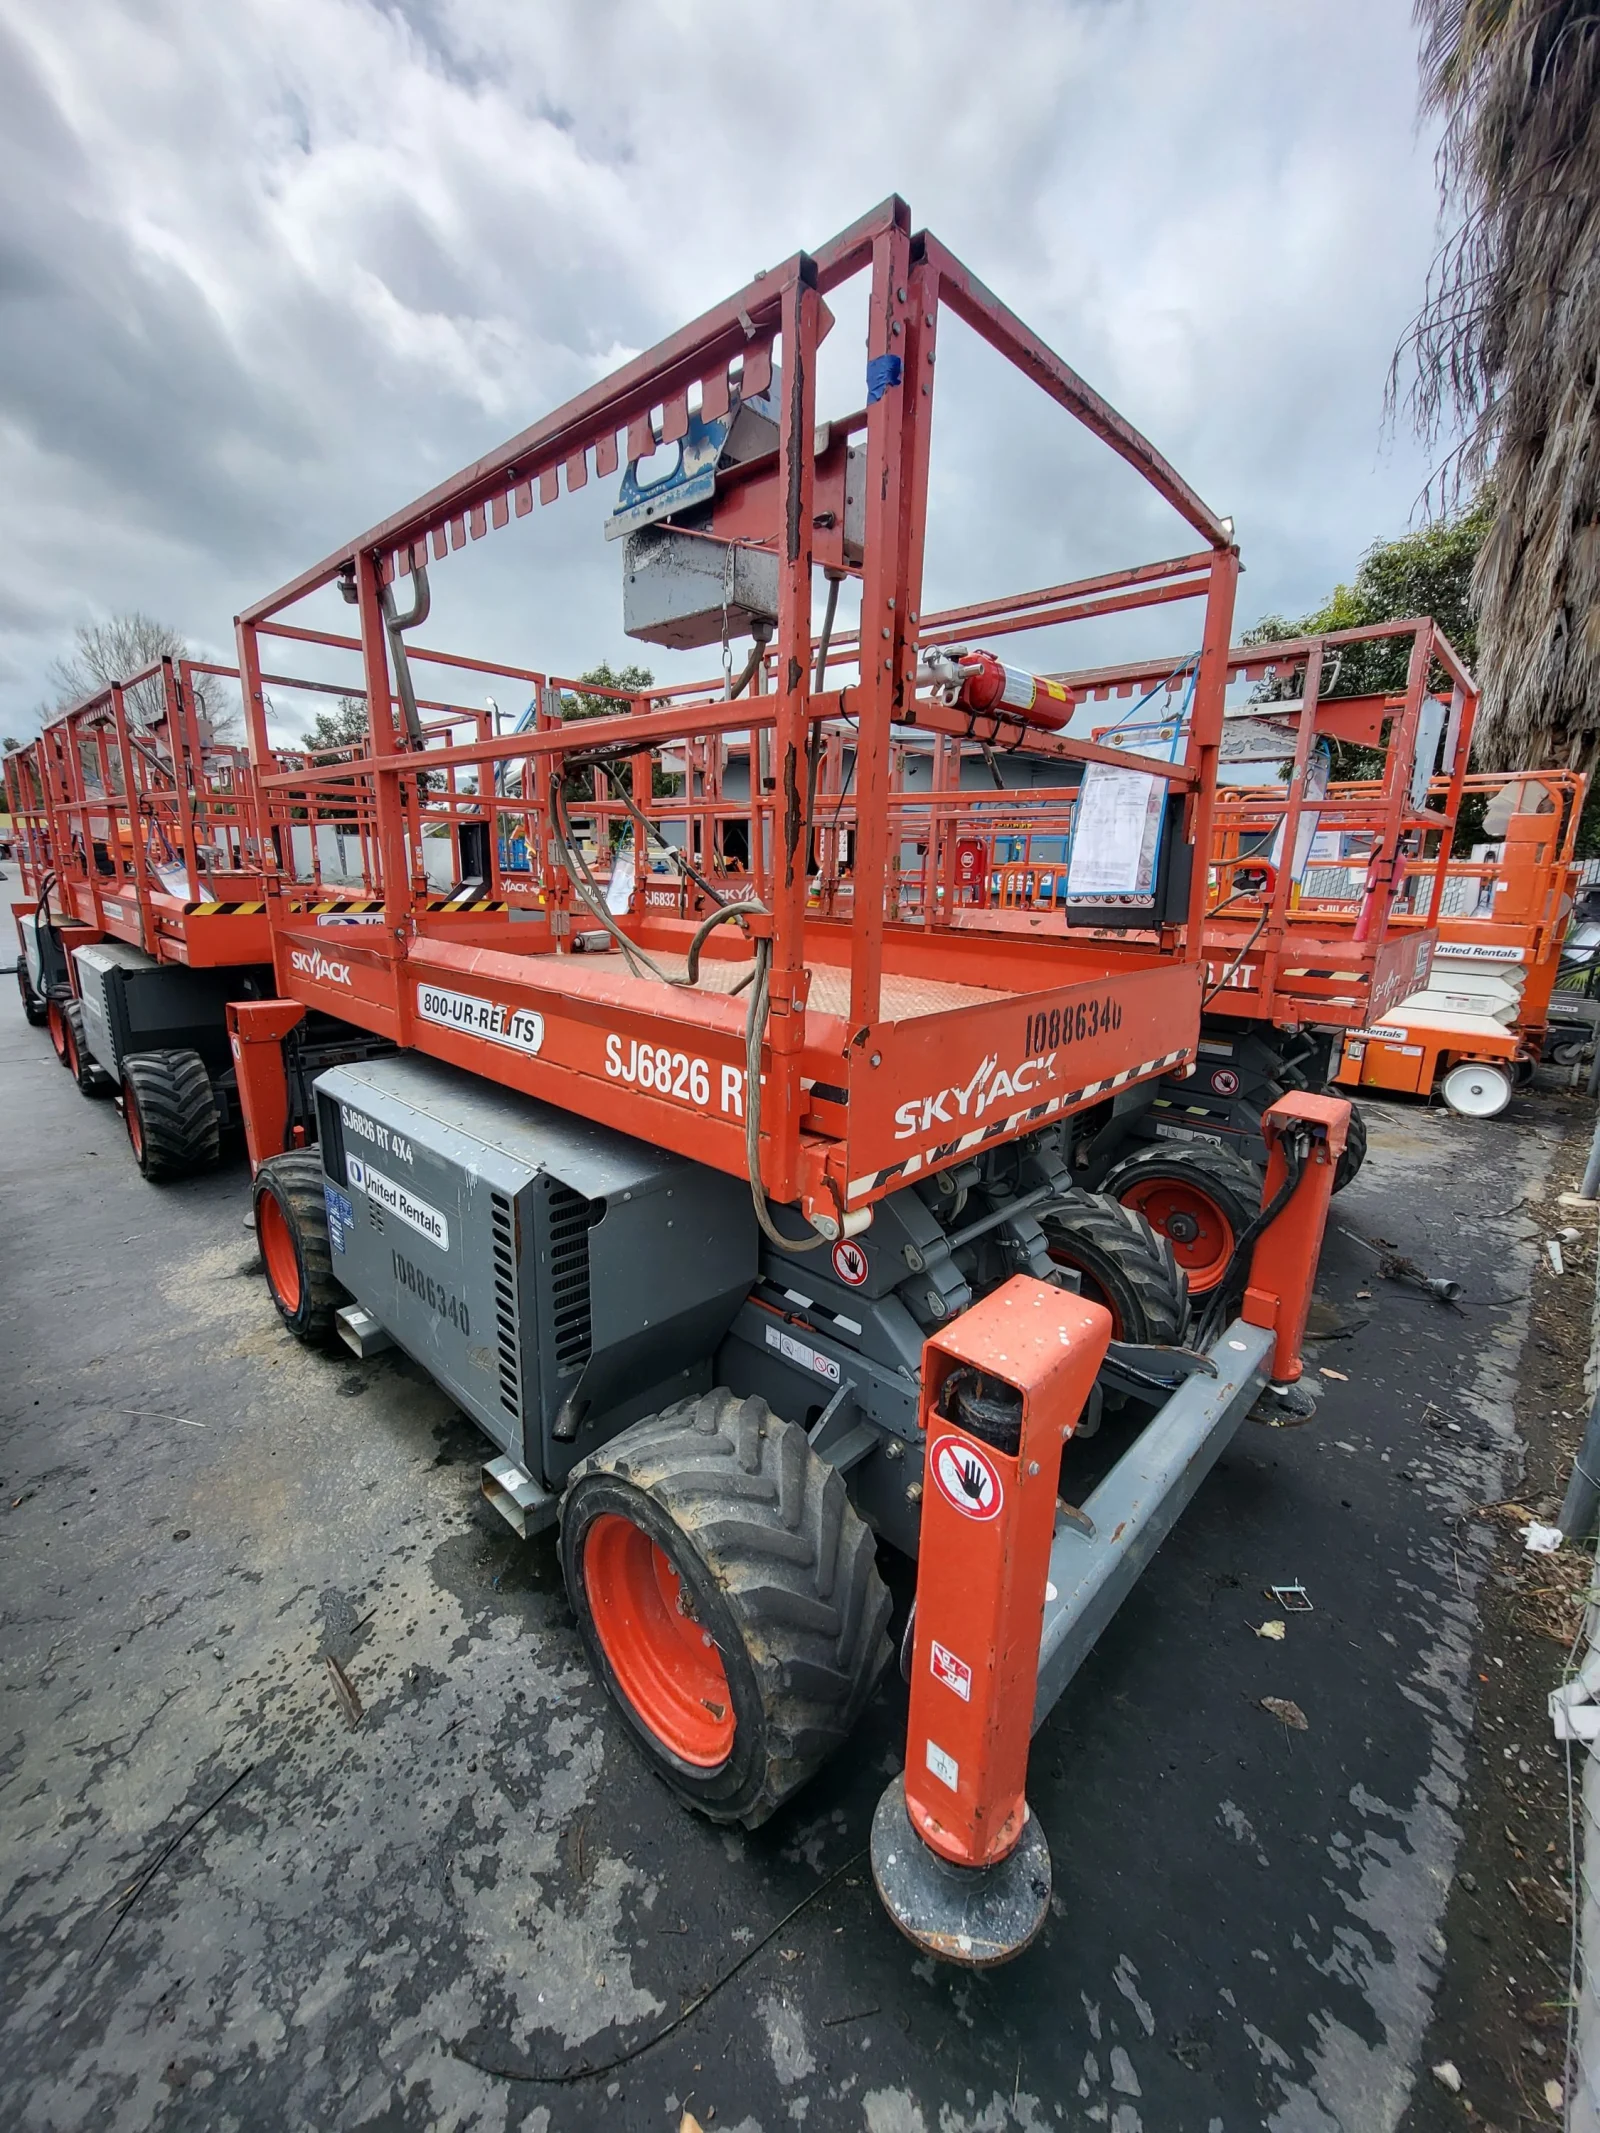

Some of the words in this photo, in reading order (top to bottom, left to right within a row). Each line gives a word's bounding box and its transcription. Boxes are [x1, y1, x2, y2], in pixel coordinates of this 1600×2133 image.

[501, 878, 529, 893] YJACK
[291, 947, 352, 987] SKYJACK
[1472, 947, 1519, 958] Rentals
[1025, 996, 1122, 1058] 10886340
[605, 1034, 710, 1105] SJ6826
[894, 1052, 1057, 1140] SKYJACK
[342, 1105, 375, 1143] SJ6826
[376, 1124, 389, 1151] RT
[391, 1135, 413, 1166] 4X4
[366, 1172, 397, 1207] United
[400, 1194, 442, 1239] Rentals
[391, 1247, 470, 1337] 10886340
